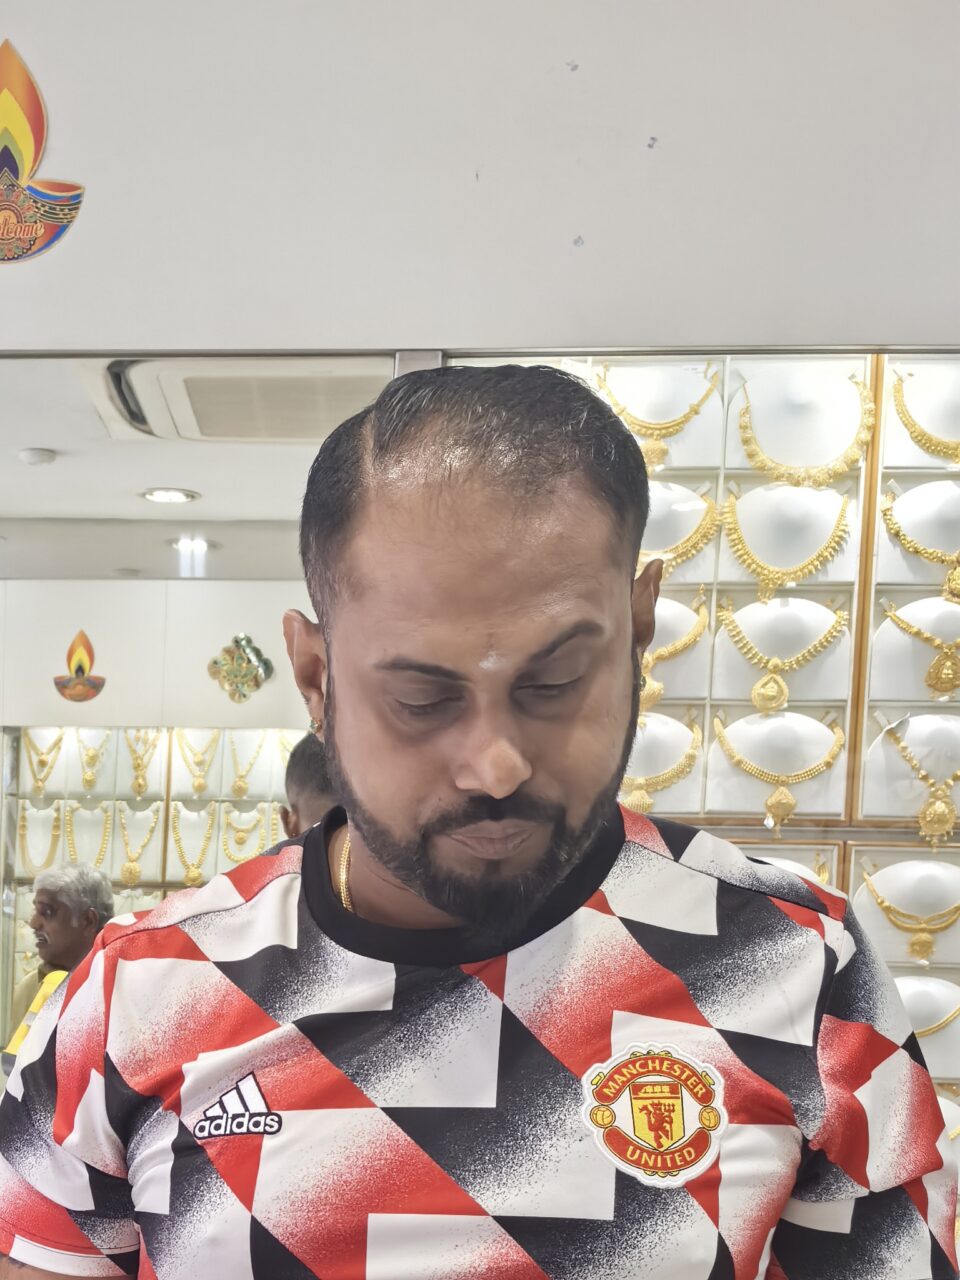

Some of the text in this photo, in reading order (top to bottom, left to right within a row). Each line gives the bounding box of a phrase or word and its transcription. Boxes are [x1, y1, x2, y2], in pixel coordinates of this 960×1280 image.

[602, 1058, 708, 1099] MANCHESTER
[193, 1109, 282, 1138] adidas
[625, 1145, 697, 1168] UNITED
